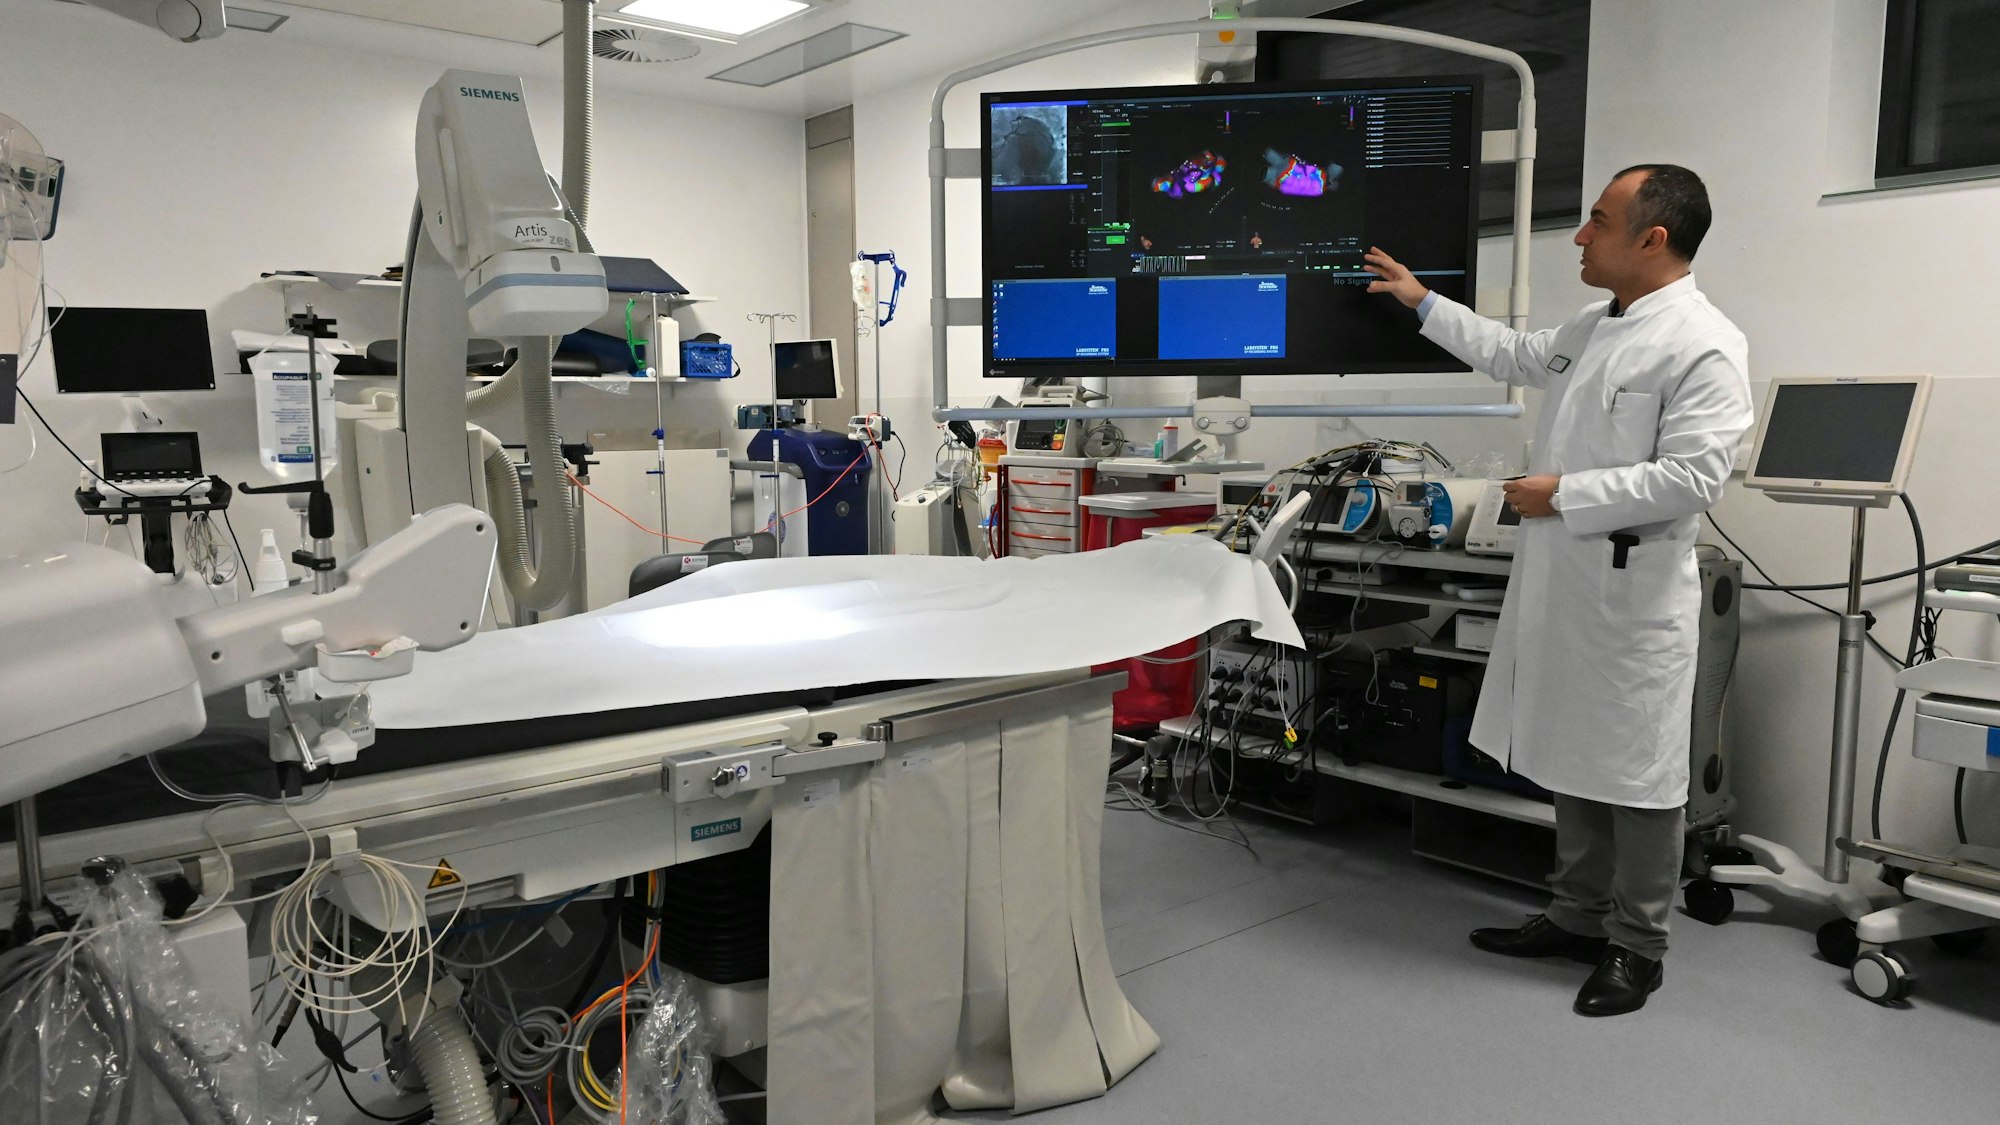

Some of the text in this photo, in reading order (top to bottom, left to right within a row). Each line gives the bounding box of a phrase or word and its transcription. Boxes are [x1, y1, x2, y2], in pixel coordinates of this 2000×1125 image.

[460, 87, 520, 102] SIEMENS
[515, 223, 548, 238] Artis
[549, 235, 571, 247] zee
[1347, 277, 1373, 286] Signal
[694, 821, 738, 838] SIEMENS
